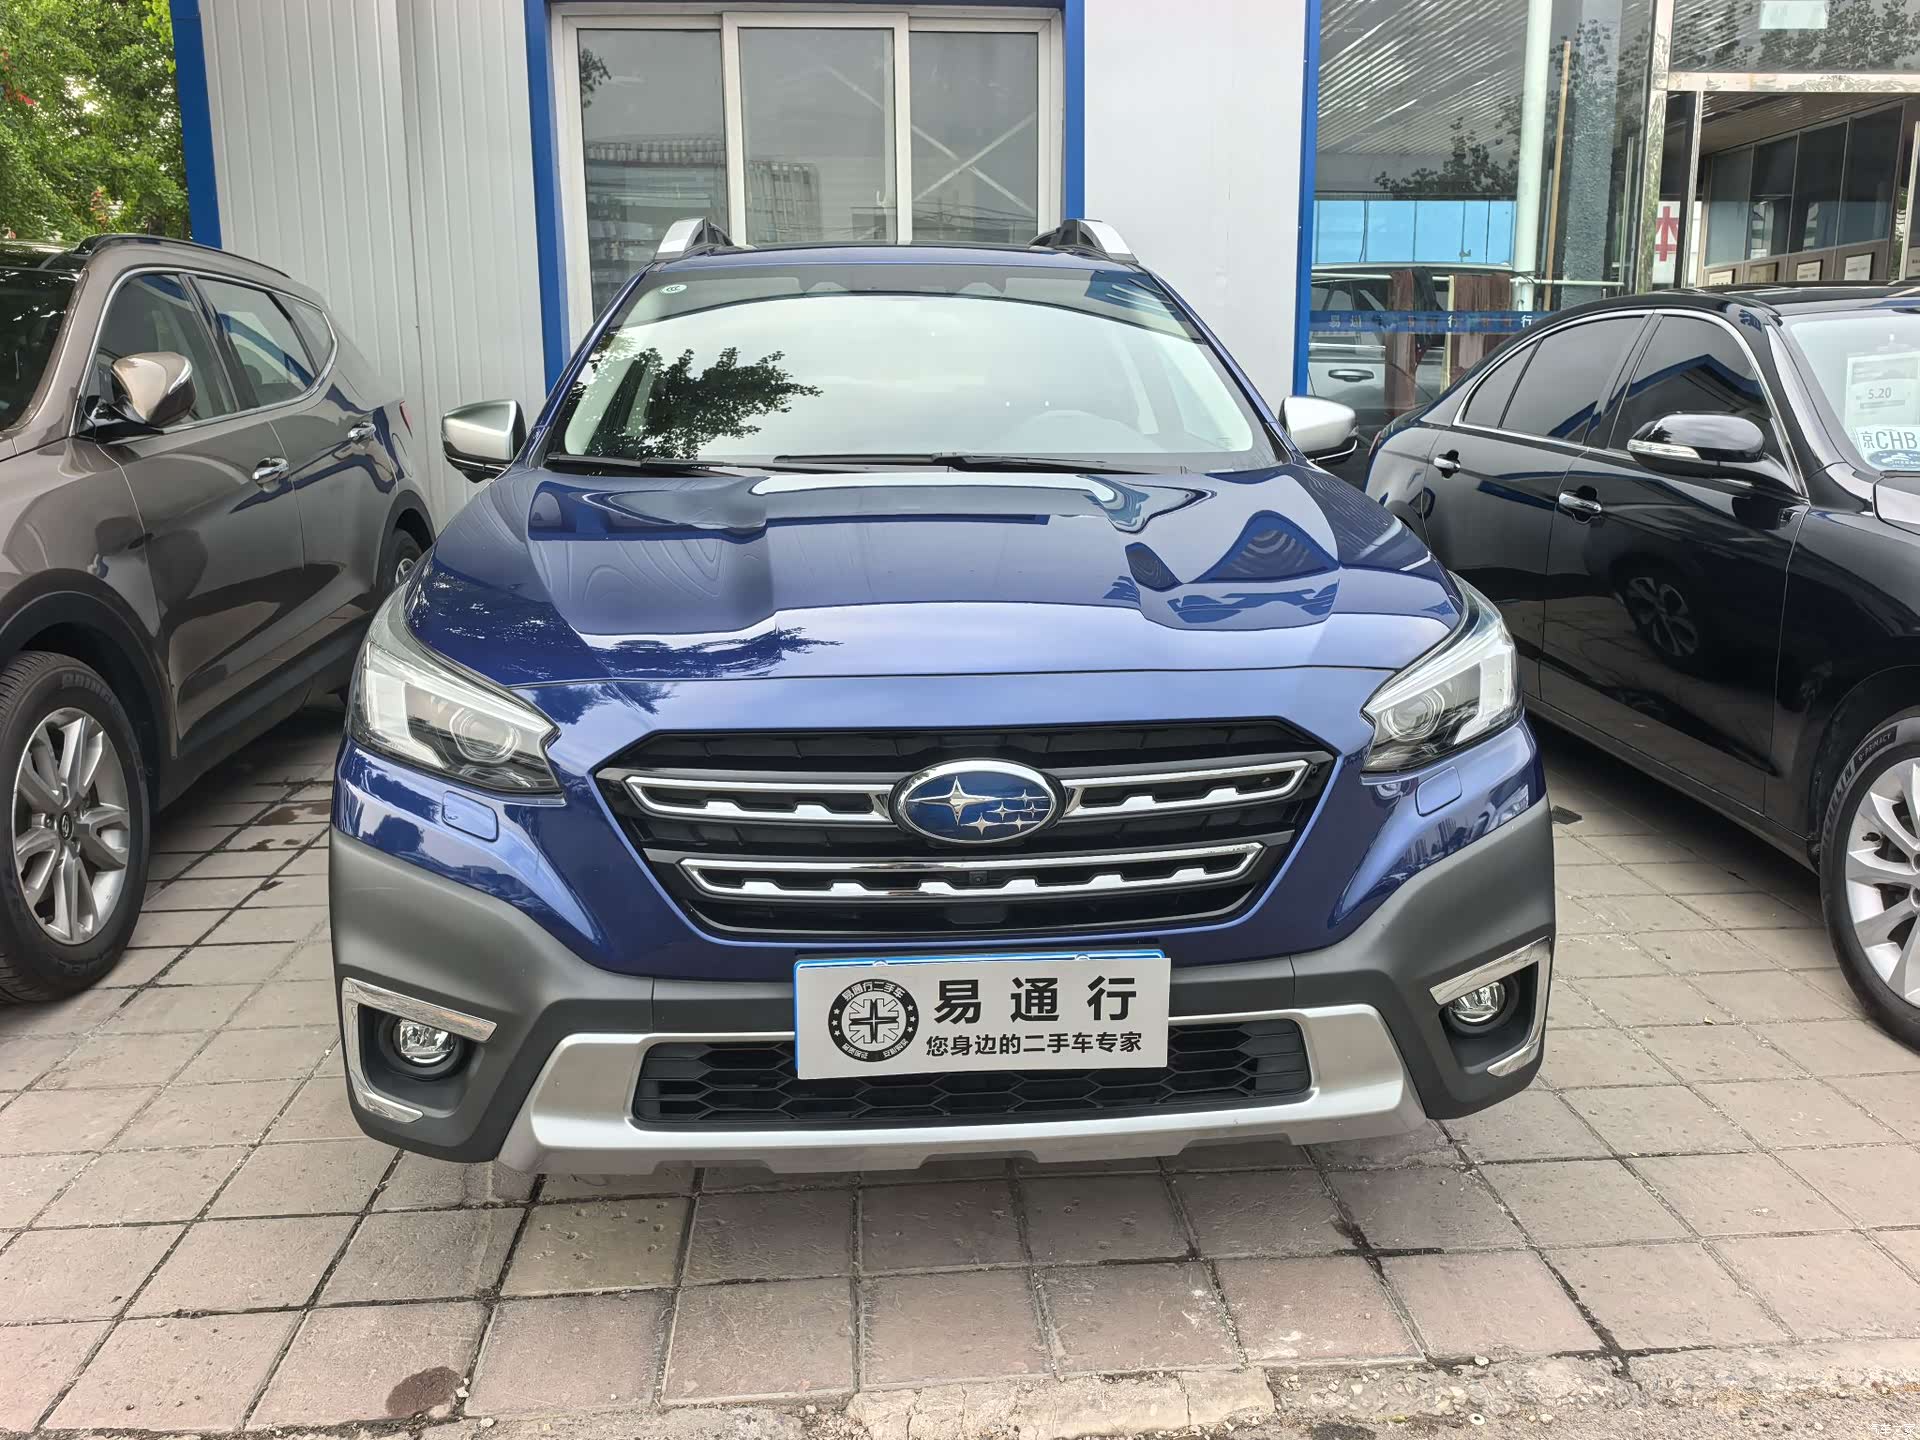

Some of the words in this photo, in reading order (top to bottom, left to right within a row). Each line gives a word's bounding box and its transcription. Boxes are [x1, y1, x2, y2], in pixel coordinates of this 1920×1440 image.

[934, 975, 1137, 1025] 易通行
[926, 1031, 1142, 1057] 您身边的二手车专家
